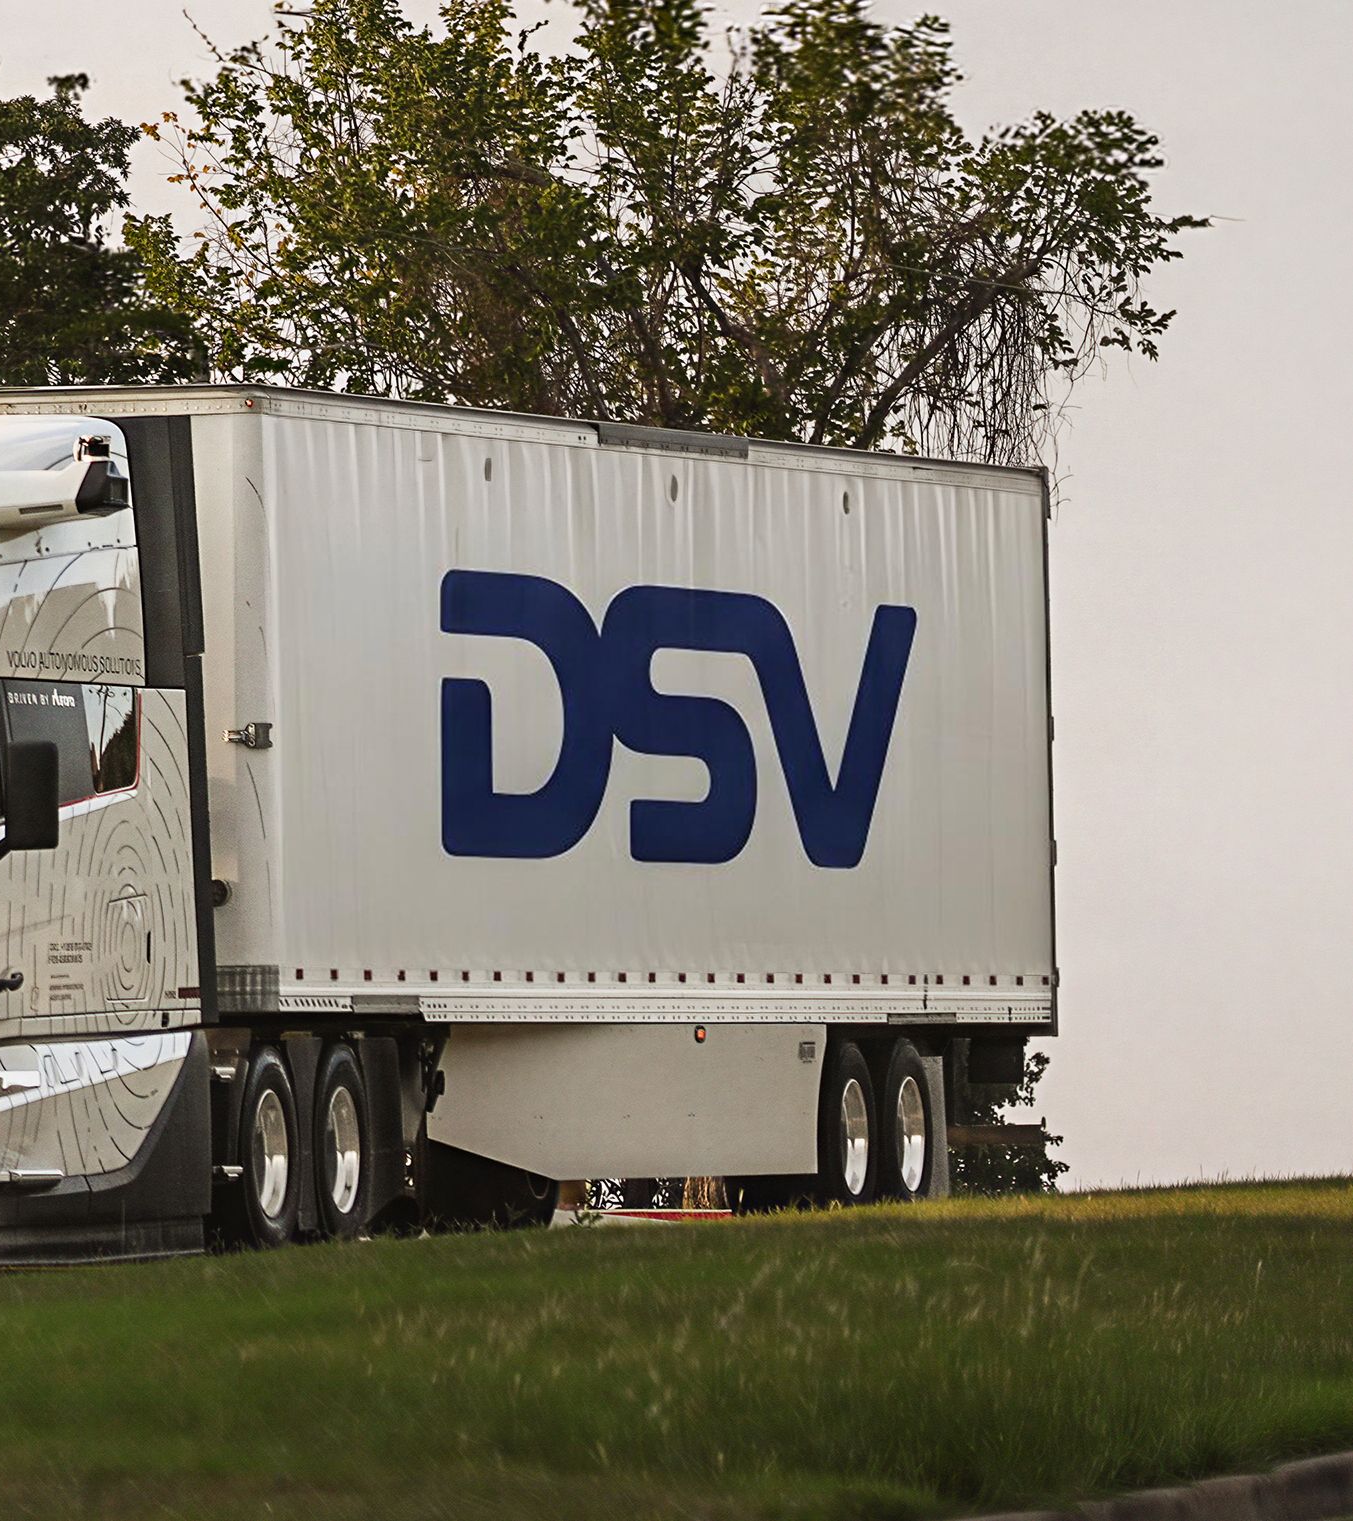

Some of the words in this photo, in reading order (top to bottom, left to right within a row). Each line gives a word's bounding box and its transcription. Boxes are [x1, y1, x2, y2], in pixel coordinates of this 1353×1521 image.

[6, 650, 37, 669] VOLVO
[39, 651, 99, 674] AUTONOMOUS
[7, 691, 38, 706] DRIVEN
[39, 693, 50, 706] BY
[440, 568, 918, 869] DSV
